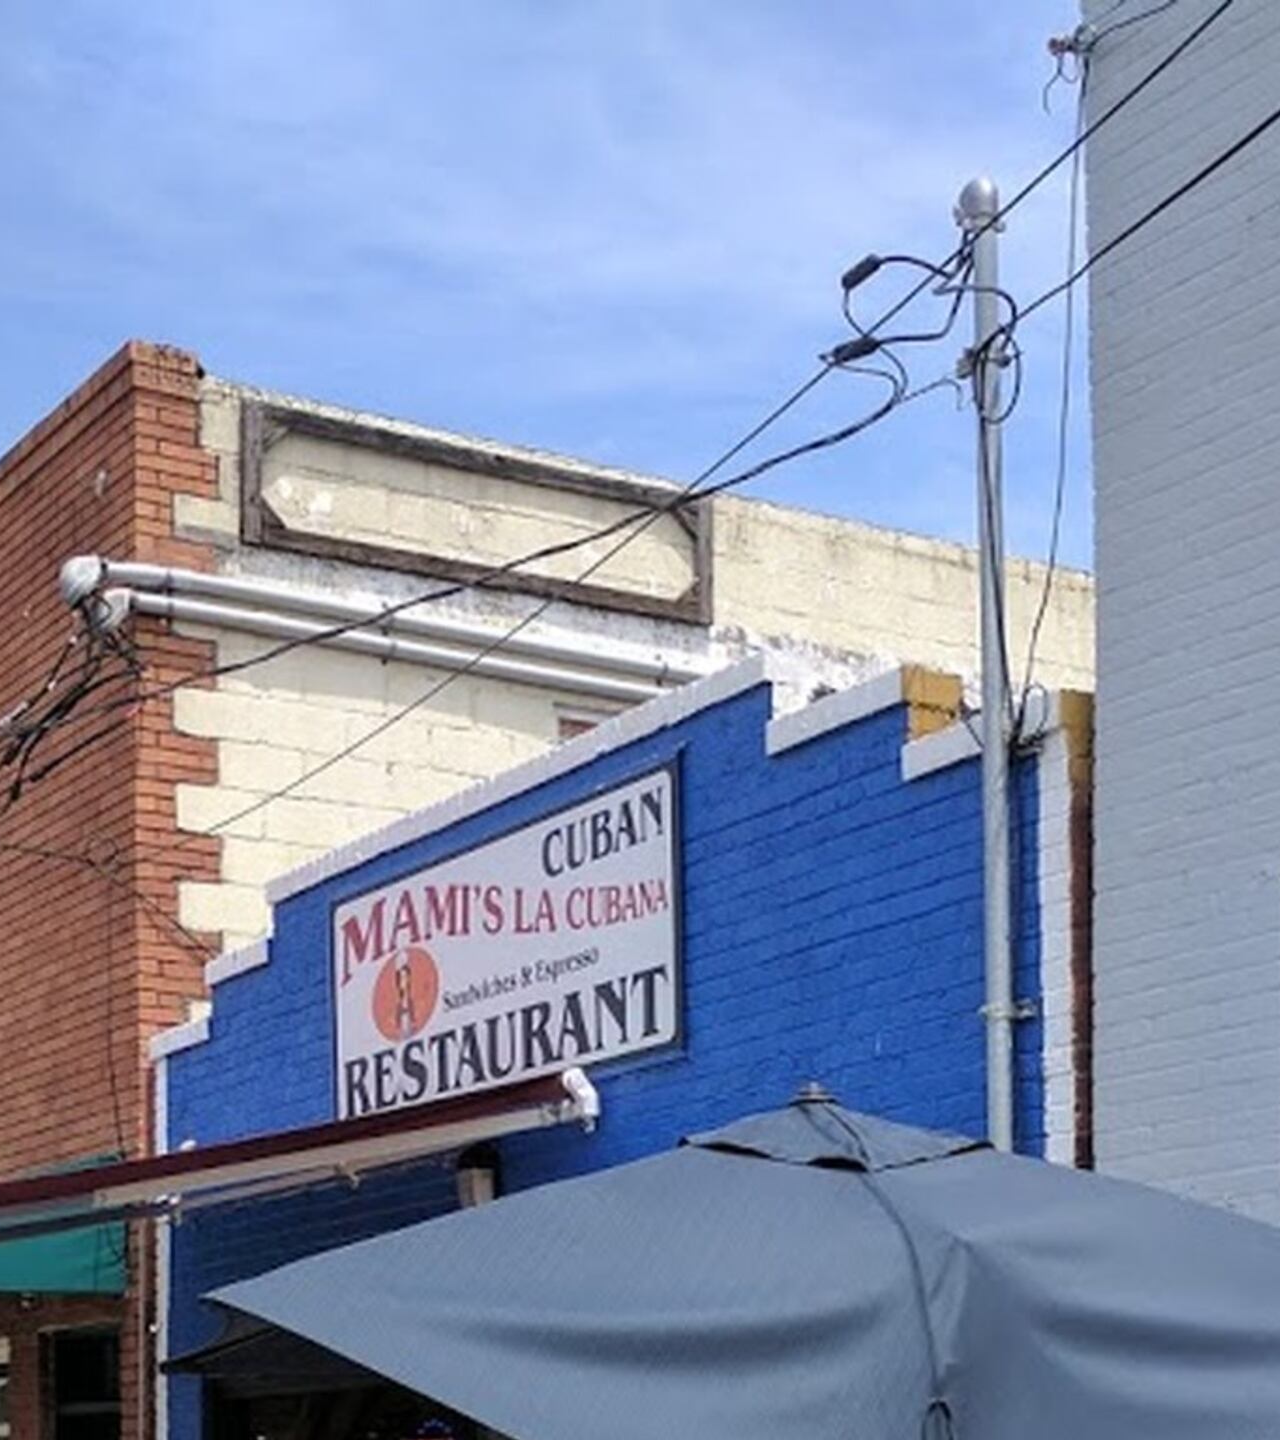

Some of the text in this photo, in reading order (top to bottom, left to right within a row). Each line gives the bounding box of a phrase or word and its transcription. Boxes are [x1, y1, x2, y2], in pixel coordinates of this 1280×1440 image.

[541, 786, 665, 878] CUBAN
[340, 880, 669, 987] MAMI'S LA CUBANA
[442, 947, 600, 1013] Sandwiches & Espresso
[344, 964, 669, 1120] RESTAURANT
